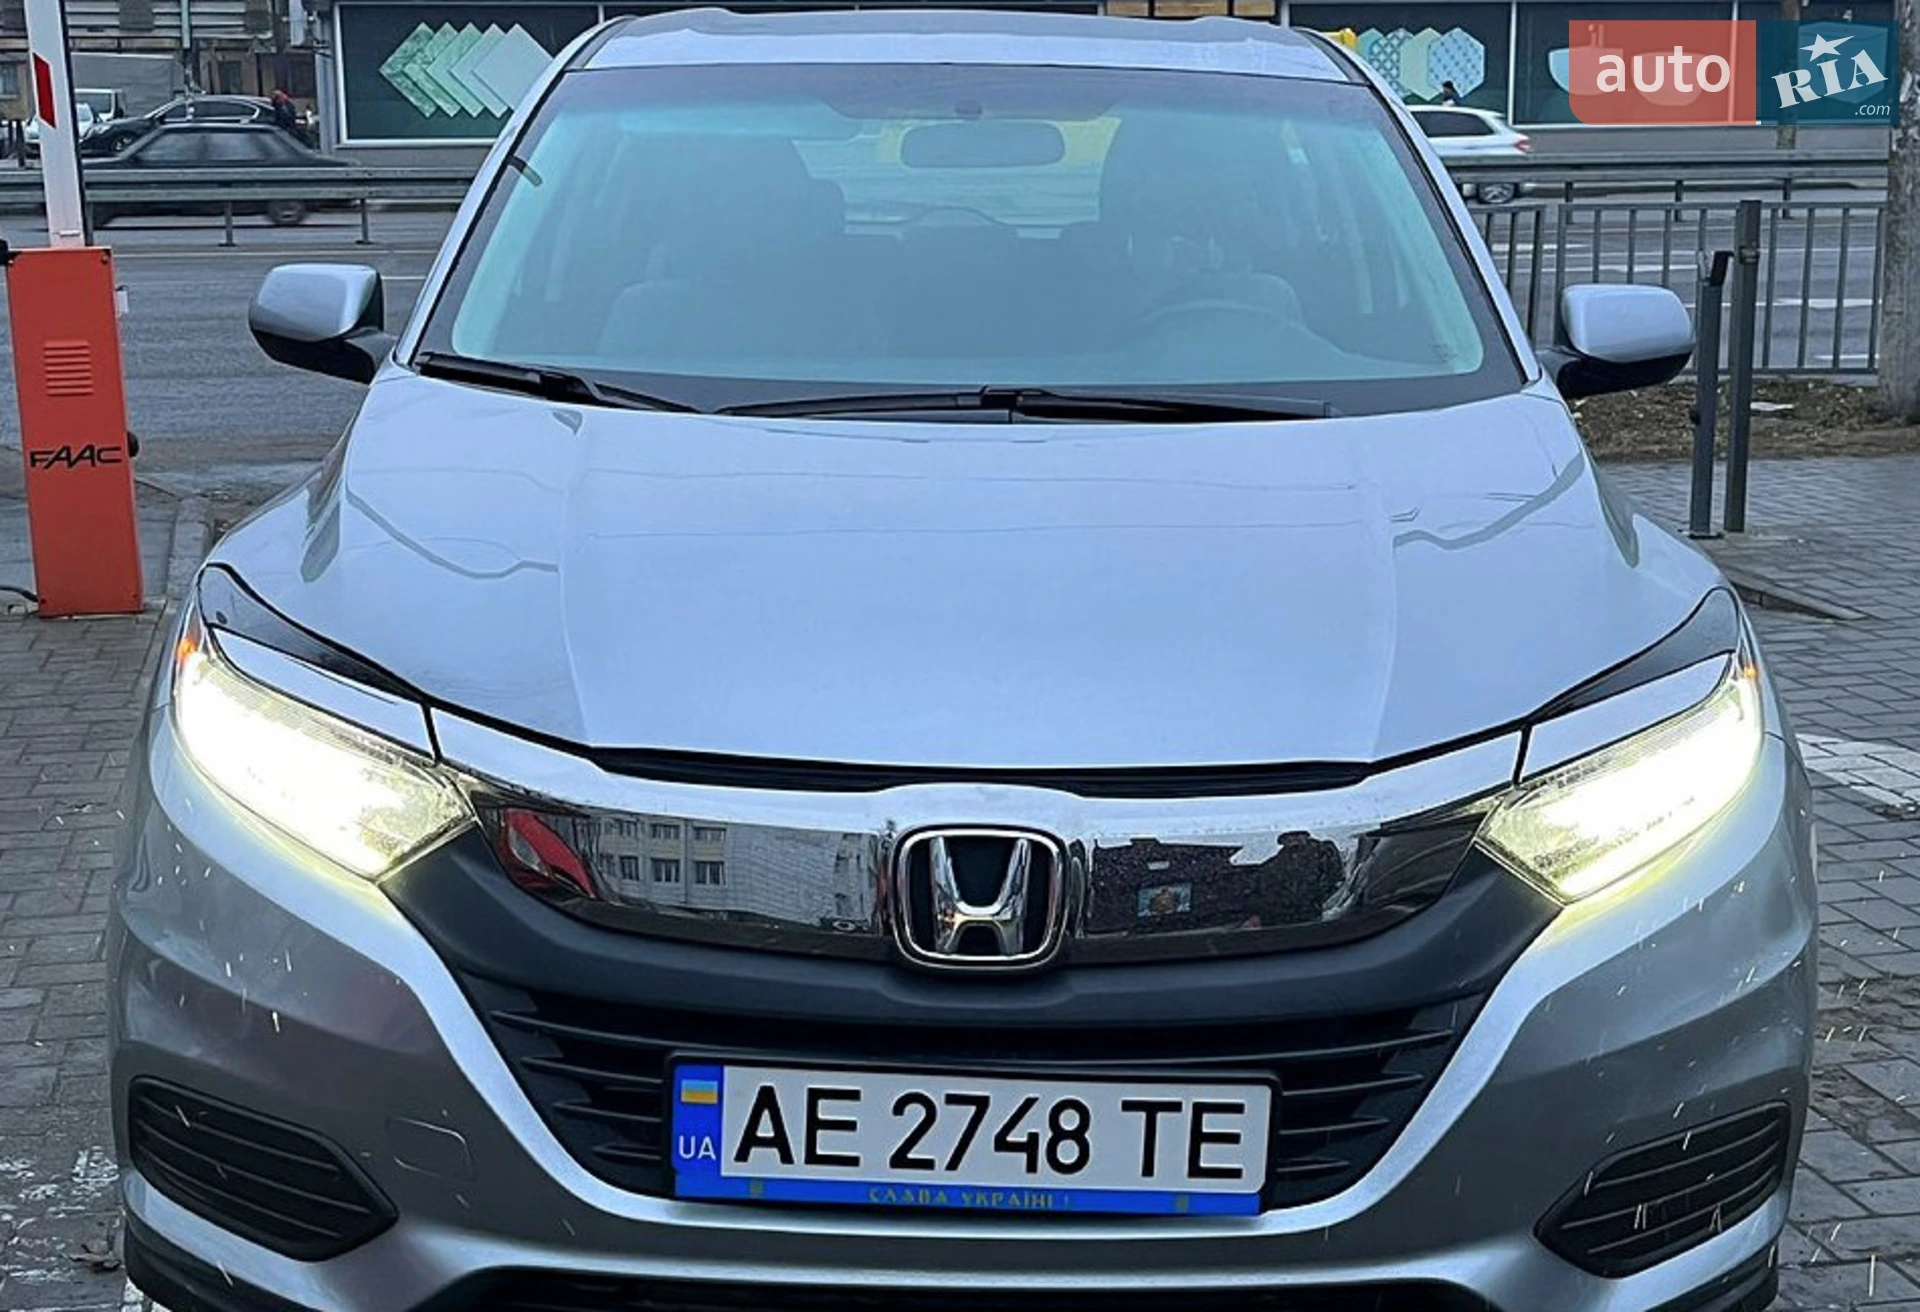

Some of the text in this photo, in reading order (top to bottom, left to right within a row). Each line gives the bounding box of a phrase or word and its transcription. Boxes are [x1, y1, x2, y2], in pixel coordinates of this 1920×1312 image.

[30, 444, 122, 469] FAAC
[733, 1085, 1246, 1180] AE 2748 TE
[678, 1135, 716, 1160] UA
